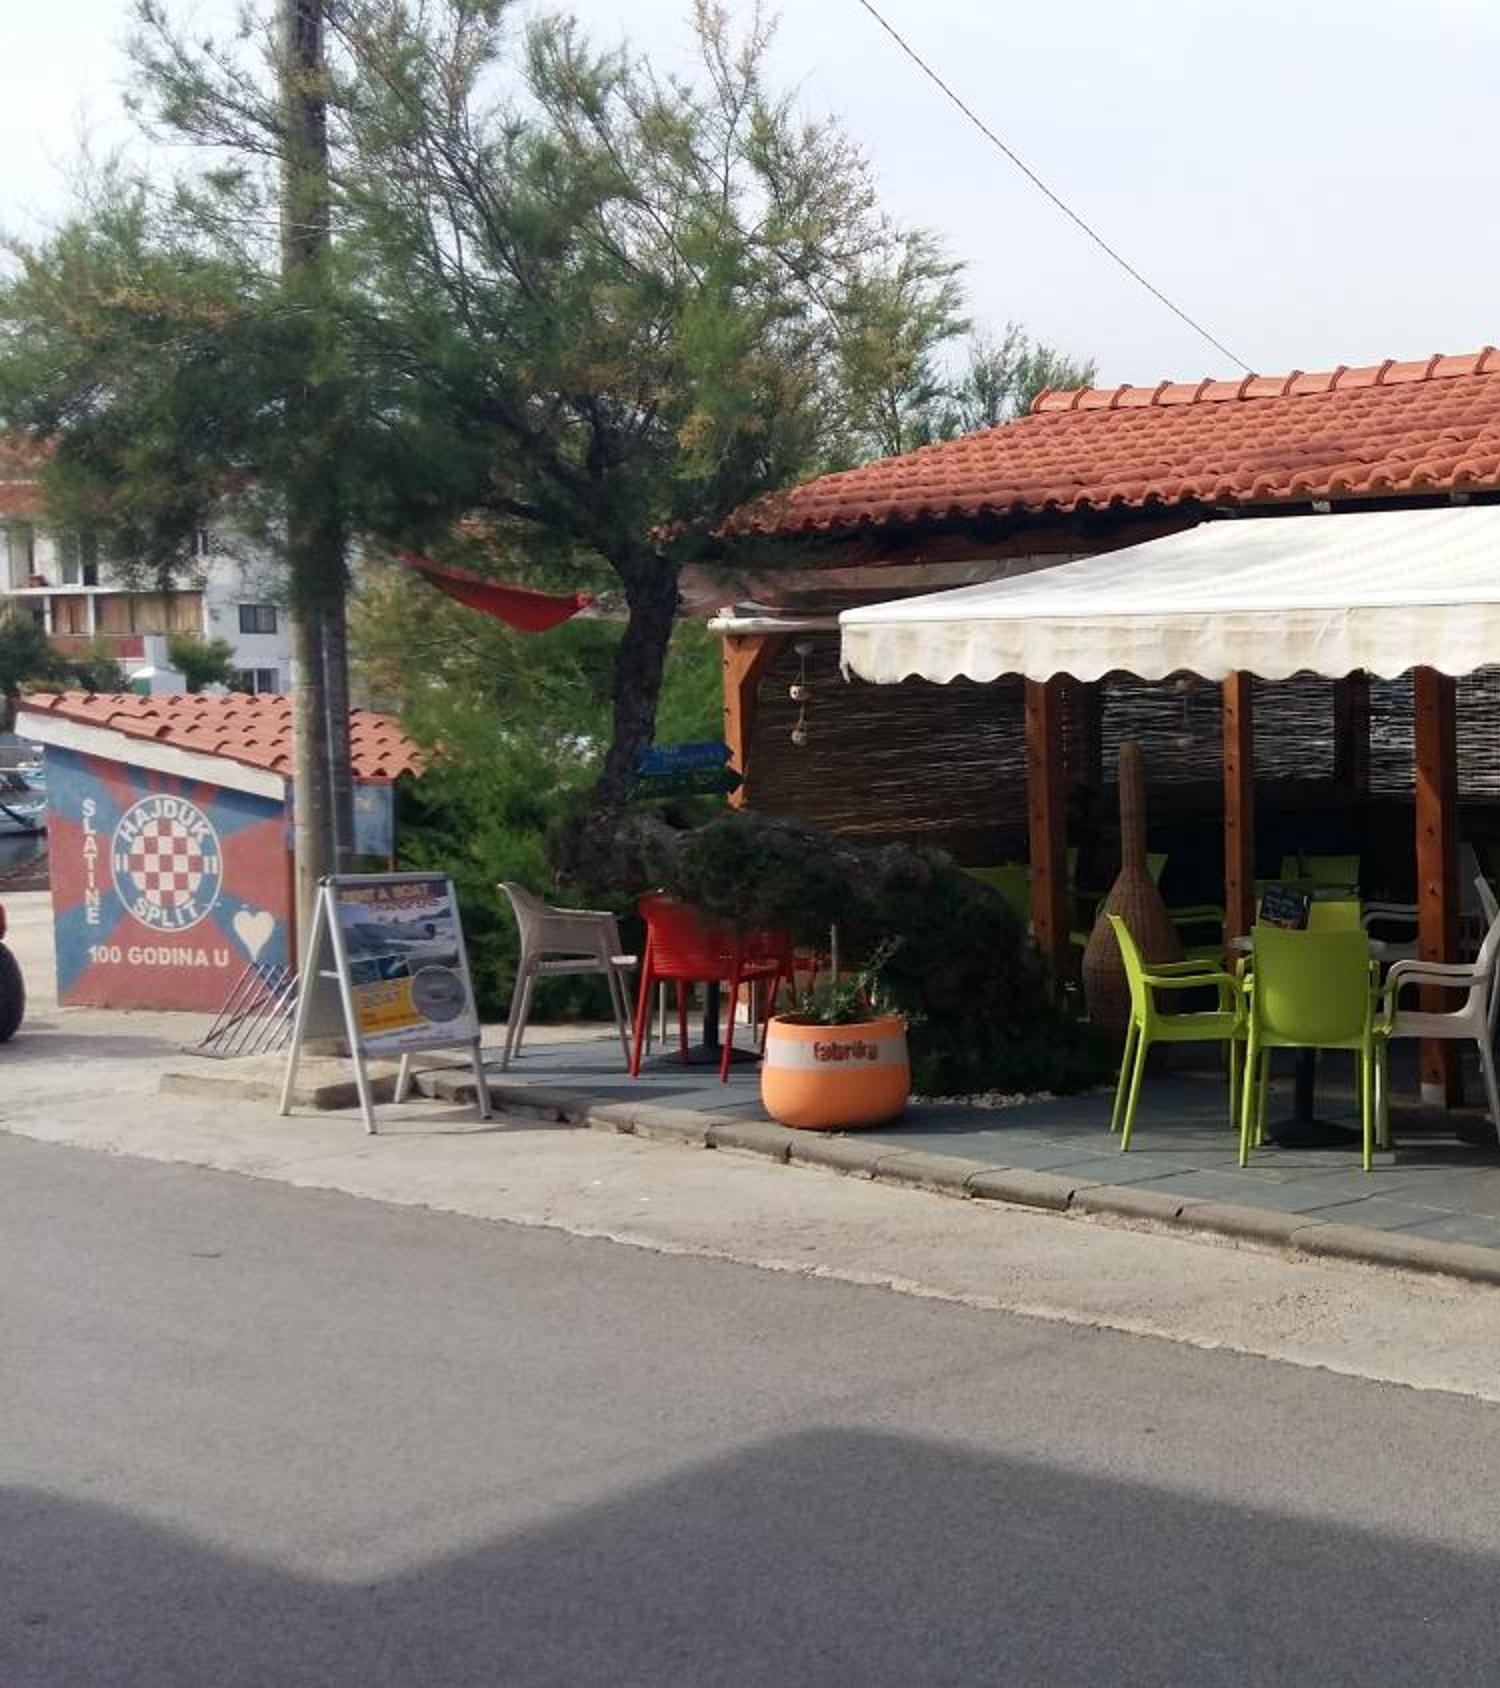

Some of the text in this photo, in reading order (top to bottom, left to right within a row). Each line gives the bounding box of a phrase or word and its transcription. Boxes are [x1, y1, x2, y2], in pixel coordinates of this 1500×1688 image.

[119, 799, 210, 843] HAJDUK
[82, 799, 100, 924] SLATINE
[132, 896, 199, 927] SPLIT
[88, 945, 230, 968] 100 GODINA U
